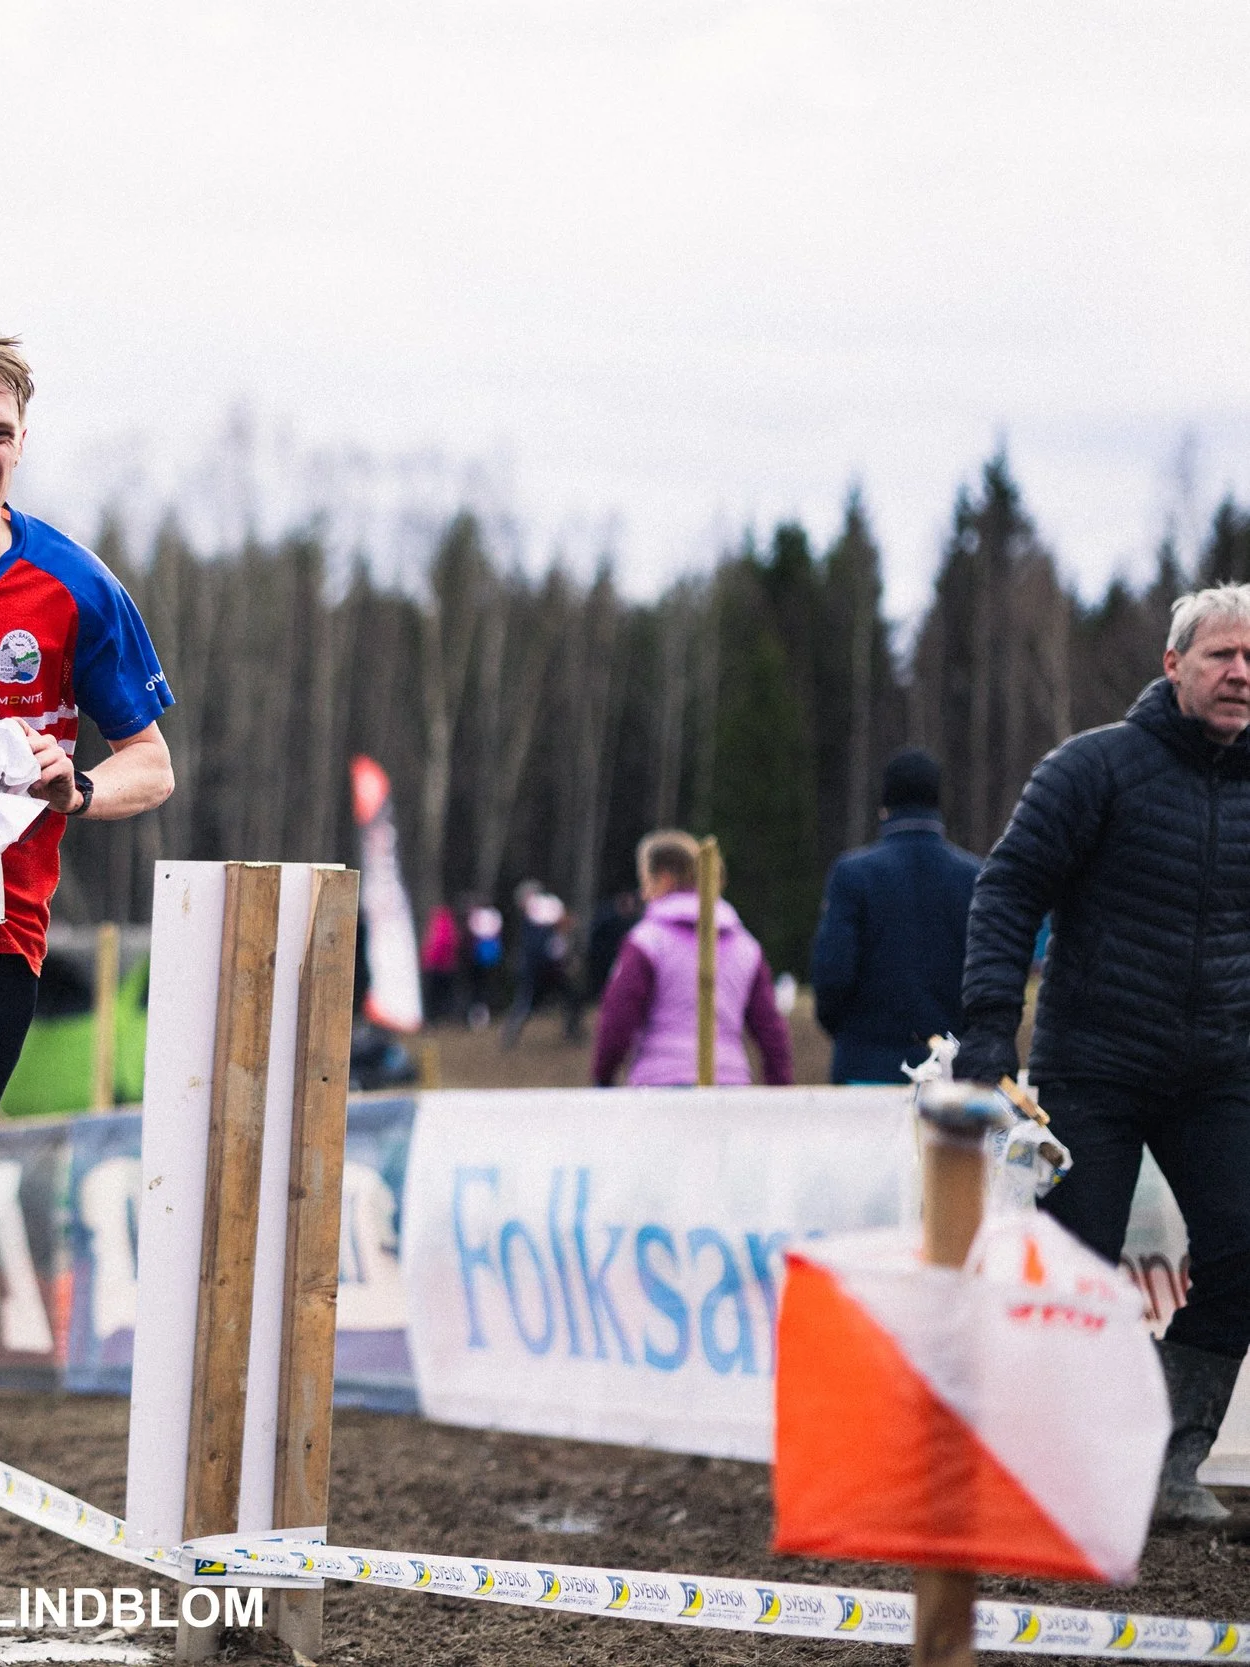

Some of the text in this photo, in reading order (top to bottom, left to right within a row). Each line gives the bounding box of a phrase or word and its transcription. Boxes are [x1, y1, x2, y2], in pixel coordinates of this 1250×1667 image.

[431, 1565, 467, 1582] SVENSK
[495, 1570, 531, 1588] SVENSK
[562, 1576, 599, 1594] SVENSK
[632, 1582, 670, 1600] SVENSK
[706, 1588, 747, 1608] SVENSK
[784, 1594, 826, 1614] SVENSK
[865, 1600, 911, 1621] SVENSK
